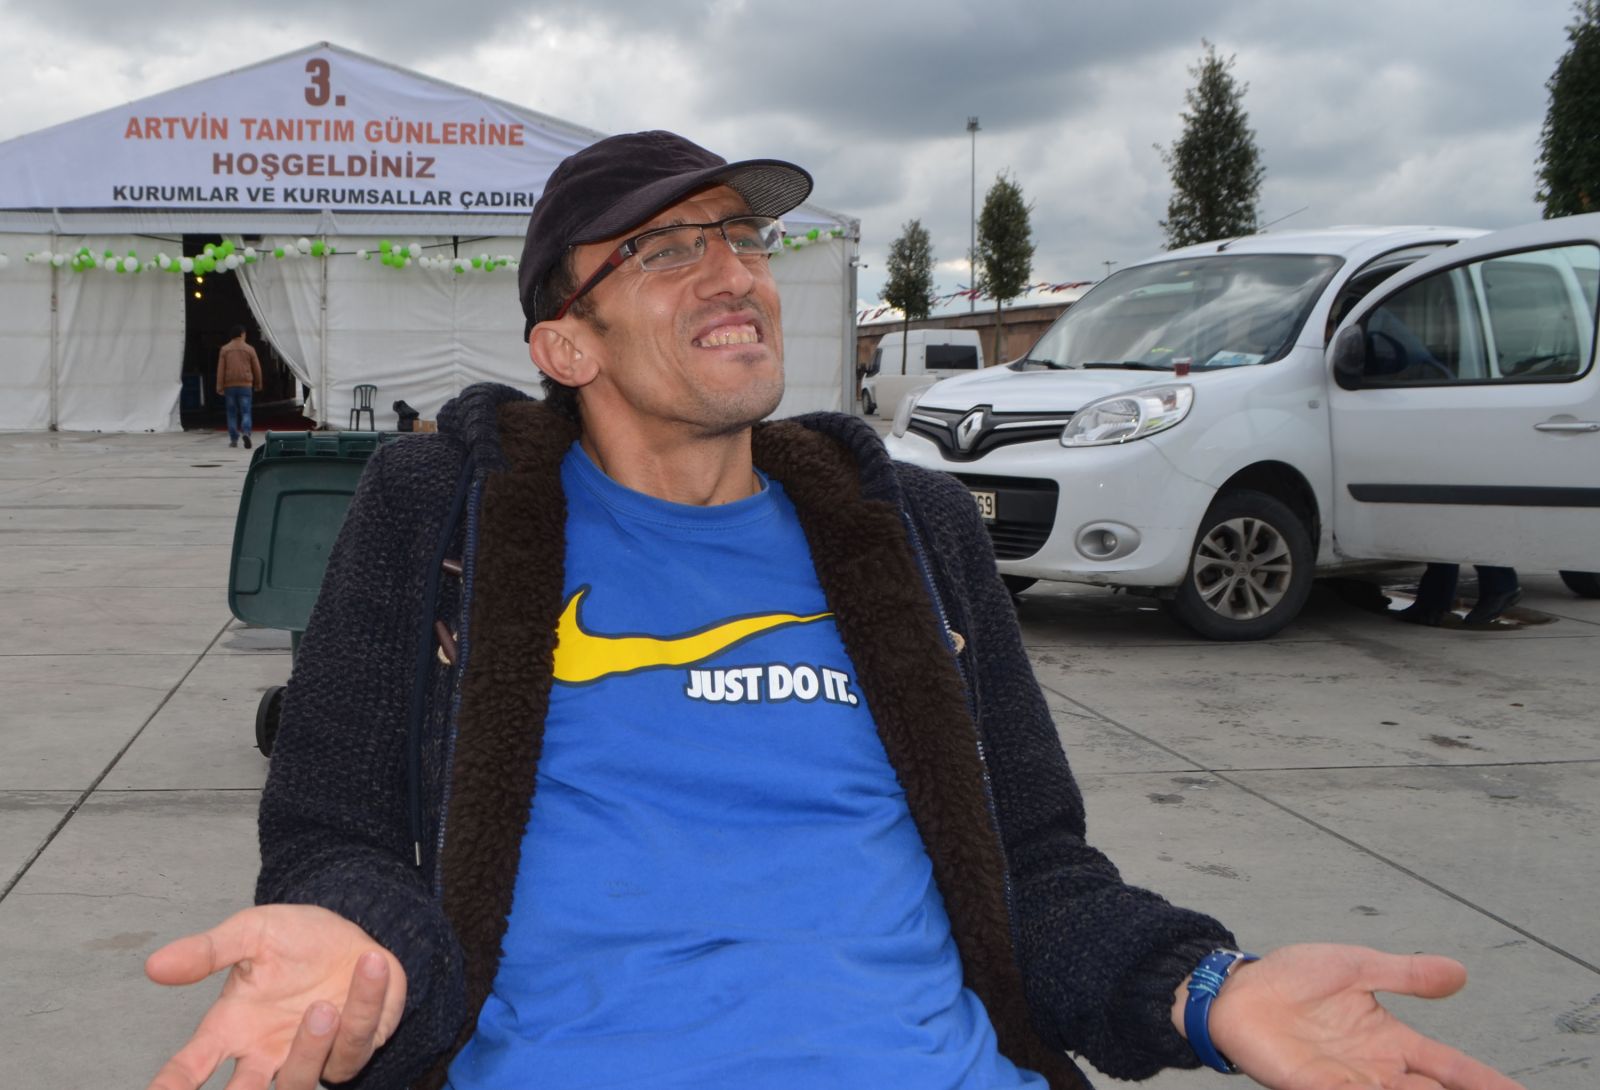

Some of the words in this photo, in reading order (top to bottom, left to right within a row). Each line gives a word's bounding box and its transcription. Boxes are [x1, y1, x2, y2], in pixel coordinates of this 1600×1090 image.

[305, 58, 346, 106] 3.
[124, 111, 228, 140] ARTVİN
[240, 119, 354, 142] TANITIM
[365, 117, 525, 146] GÜNLERİNE
[213, 151, 435, 181] HOŞGELDİNİZ
[112, 185, 239, 203] KURUMLAR
[247, 187, 275, 204] VE
[283, 188, 452, 207] KURUMSALLAR
[687, 667, 763, 702] JUST
[768, 664, 820, 701] DO
[822, 668, 858, 705] IT.
